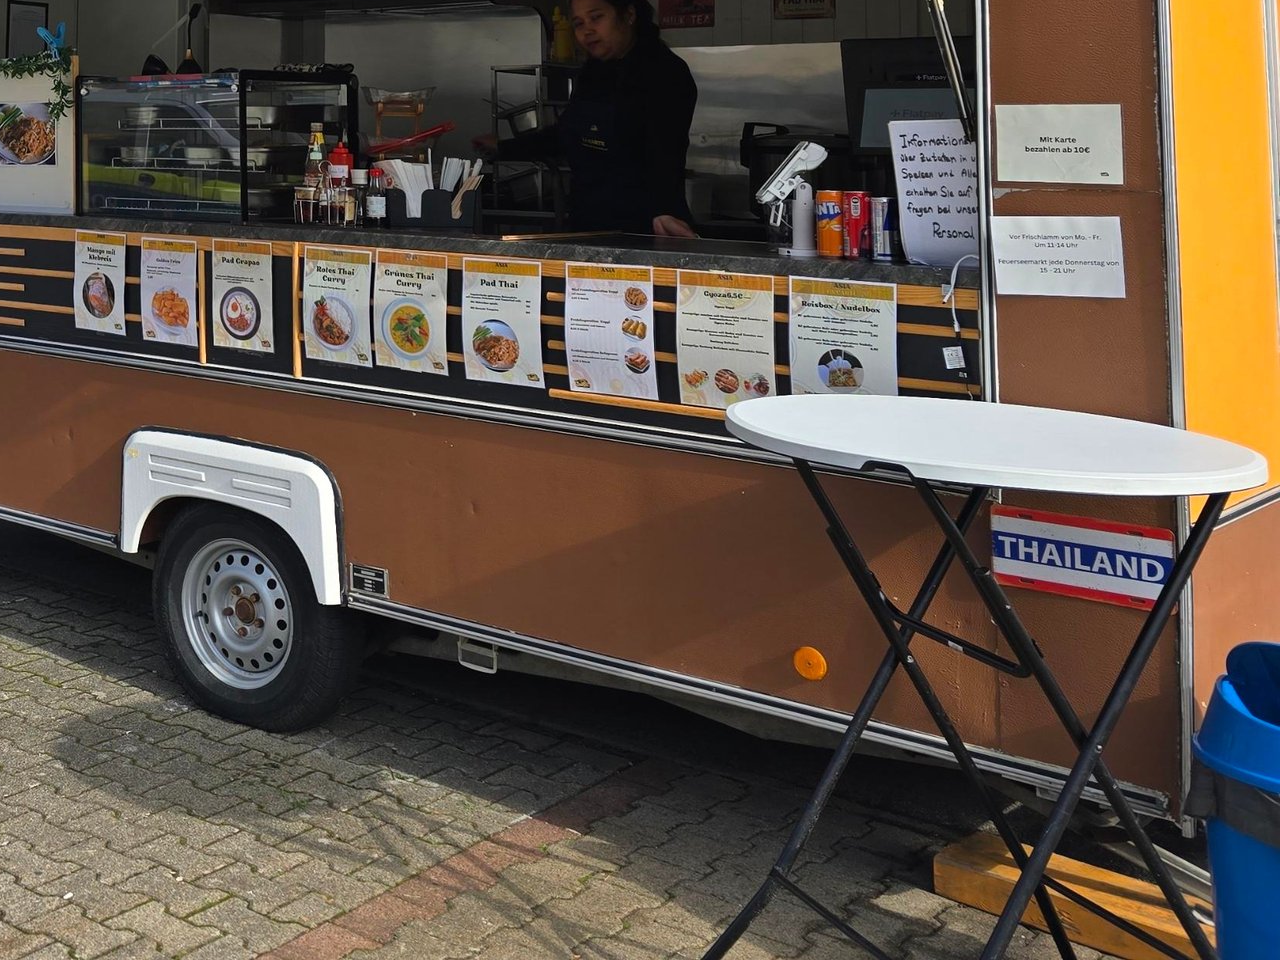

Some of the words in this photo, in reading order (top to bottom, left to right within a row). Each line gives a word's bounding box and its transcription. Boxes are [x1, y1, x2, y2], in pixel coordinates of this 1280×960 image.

[938, 168, 954, 177] und
[940, 185, 954, 197] Sie
[221, 256, 234, 264] Pad
[1065, 259, 1105, 267] Donnerstag
[316, 265, 335, 274] Rotes
[337, 267, 355, 276] Thai
[322, 275, 346, 285] Curry
[416, 272, 435, 281] Thai
[396, 279, 422, 290] Curry
[480, 278, 496, 287] Pad
[498, 280, 519, 289] Thai
[801, 300, 833, 309] Reisbox
[841, 304, 880, 314] Nudelbox
[998, 535, 1165, 582] THAILAND
